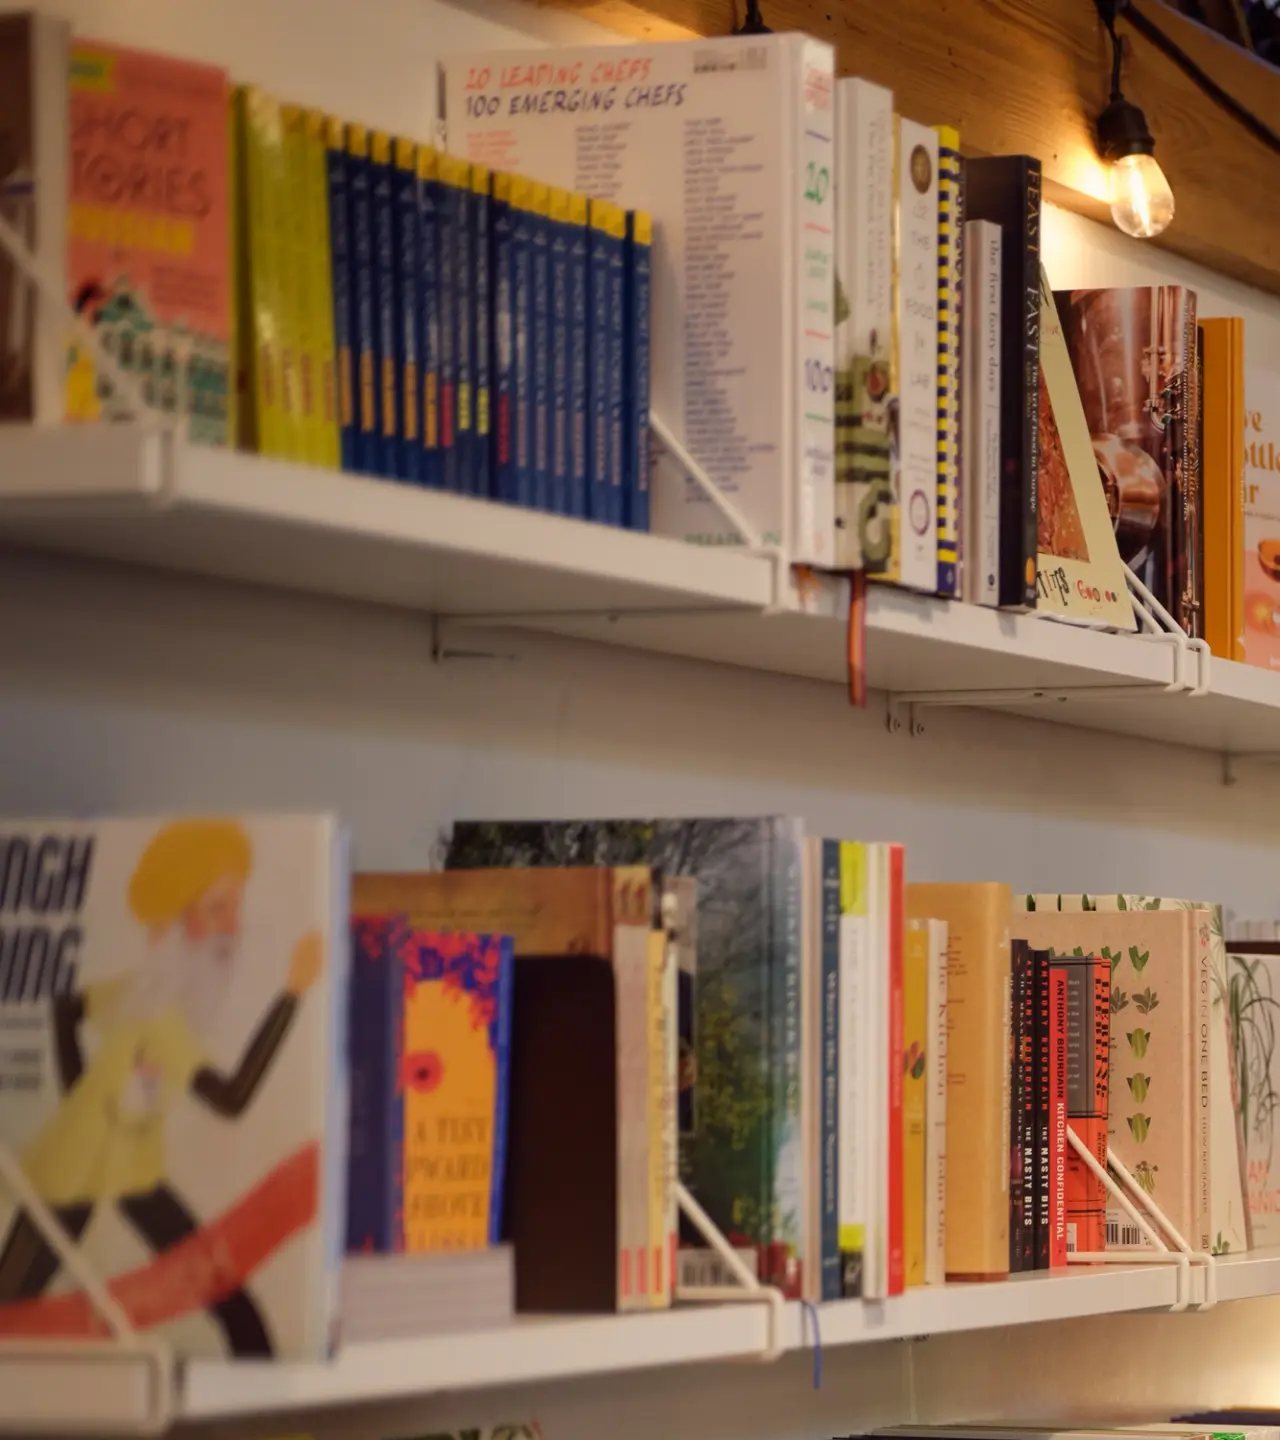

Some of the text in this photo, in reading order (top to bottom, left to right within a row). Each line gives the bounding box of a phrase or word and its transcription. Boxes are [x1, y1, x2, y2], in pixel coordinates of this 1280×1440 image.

[501, 62, 585, 87] LEADING
[597, 57, 653, 83] CHEFS
[467, 83, 687, 117] 100 EMERGING CHEFS
[1026, 168, 1040, 253] FEAST
[988, 271, 999, 304] first
[987, 312, 999, 351] forty
[1026, 286, 1039, 351] FAST
[987, 356, 998, 392] days
[1029, 469, 1037, 513] Europe
[1040, 960, 1049, 1026] ANTHONY
[938, 1003, 947, 1097] Kitchen
[1199, 955, 1209, 1109] VEG IN ONE BED
[1040, 1036, 1049, 1111] BOURDAIN
[1056, 979, 1065, 1241] ANTHONY BOURDAIN KITCHEN CONFIDENTIAL
[1040, 1147, 1049, 1189] NASTY
[1040, 1195, 1049, 1226] BITS
